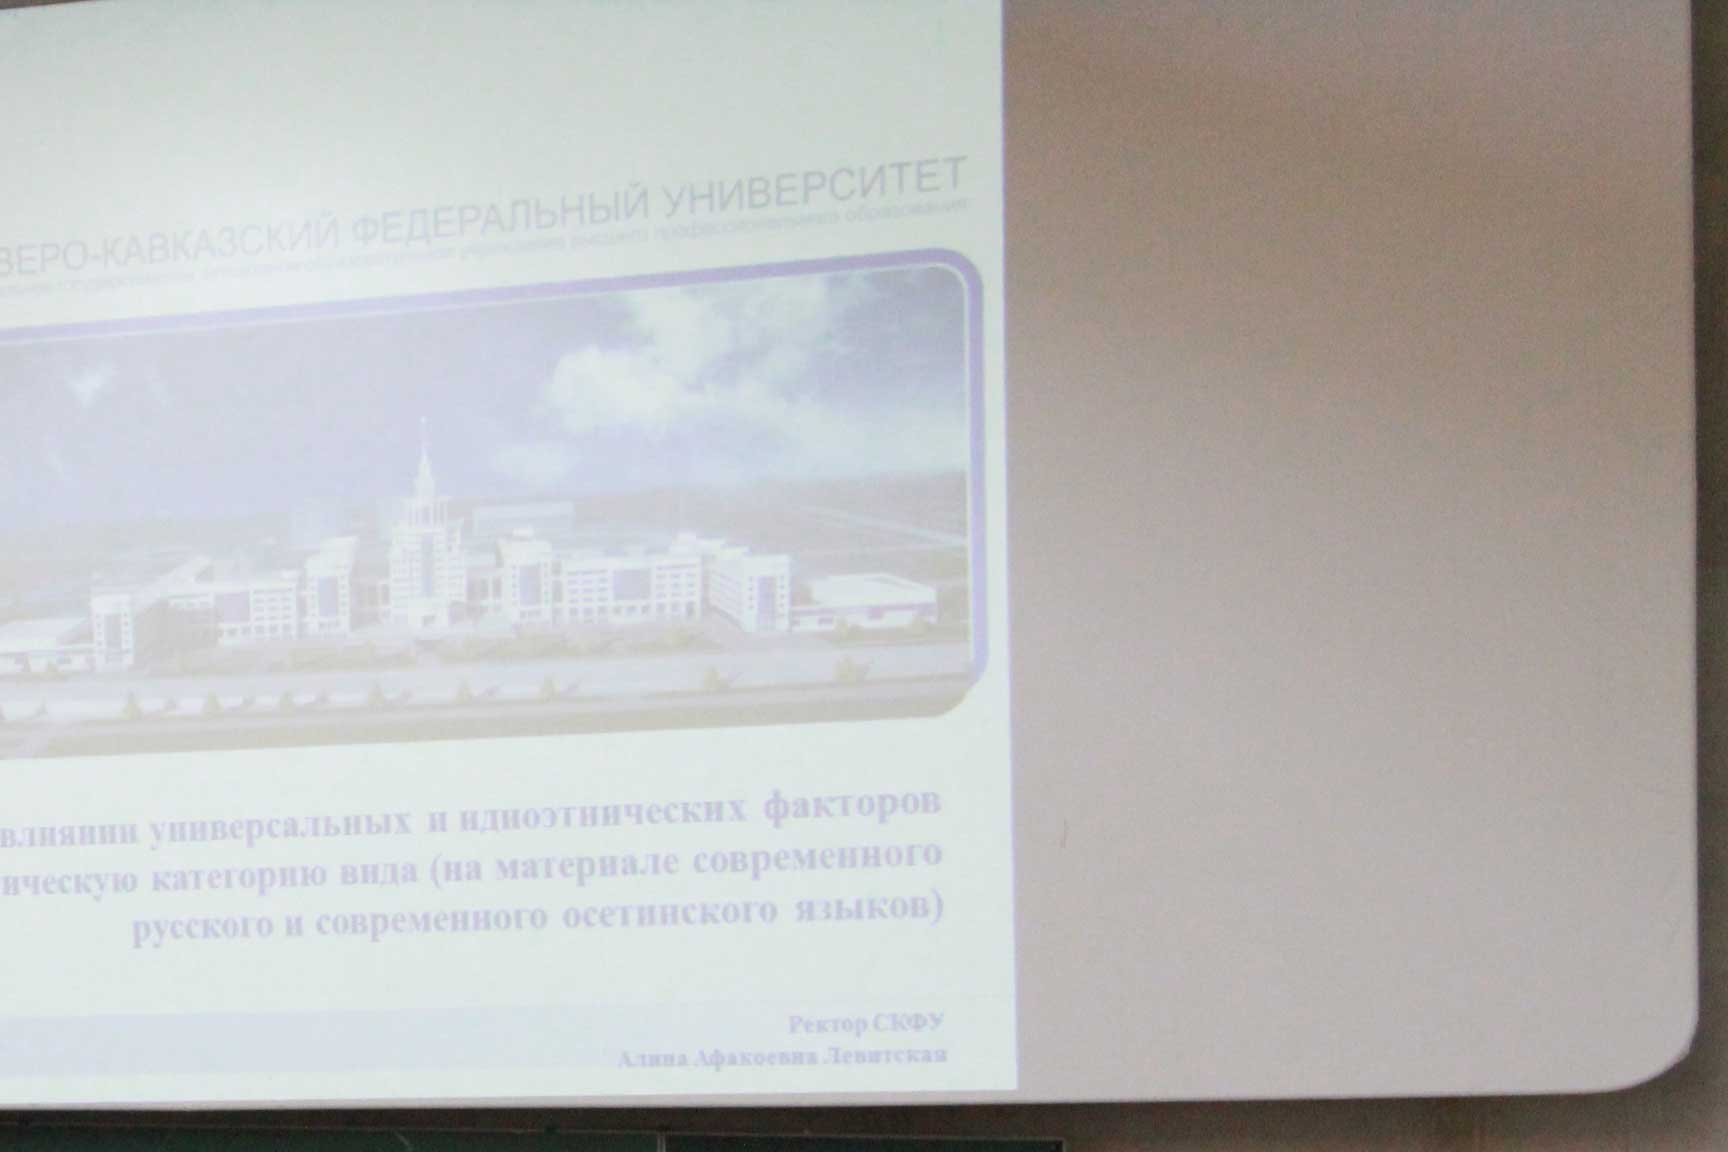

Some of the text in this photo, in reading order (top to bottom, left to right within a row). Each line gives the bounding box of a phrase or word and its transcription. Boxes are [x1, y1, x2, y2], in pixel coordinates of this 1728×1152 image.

[352, 181, 649, 246] ФЕДЕРАЛЬНЫЙ
[662, 154, 969, 218] УНИВЕРСИТЕТ
[0, 819, 139, 849] влиянии
[149, 811, 412, 851] универсальных
[426, 808, 447, 833] и
[459, 799, 747, 834] идиоэтнических
[764, 788, 942, 828] факторов
[152, 862, 327, 897] категорию
[340, 859, 418, 886] вида
[430, 850, 482, 891] (на
[495, 846, 679, 886] материале
[693, 840, 943, 880] современного
[132, 887, 945, 949] русского и современного осетинского языков)
[789, 1012, 945, 1038] Ректор СКФУ
[618, 1050, 688, 1069] Алина
